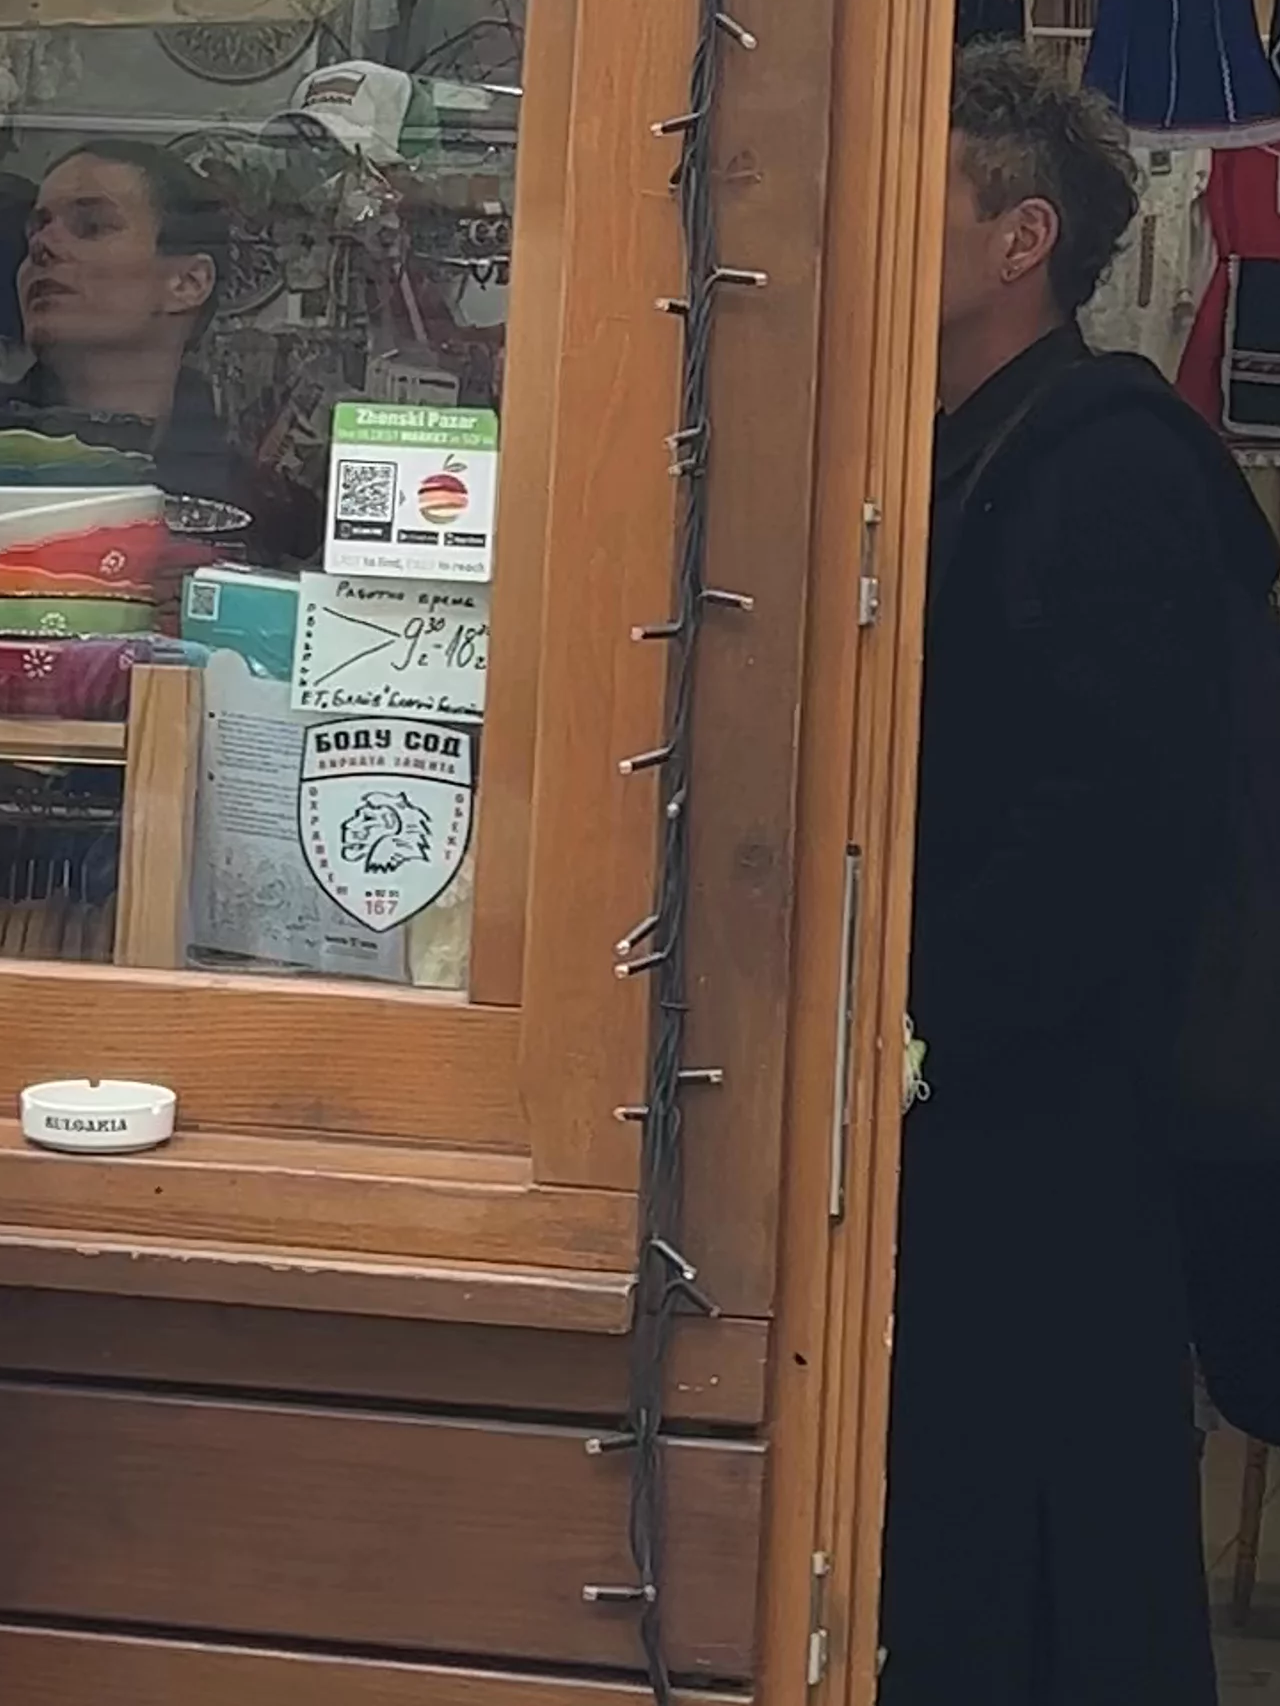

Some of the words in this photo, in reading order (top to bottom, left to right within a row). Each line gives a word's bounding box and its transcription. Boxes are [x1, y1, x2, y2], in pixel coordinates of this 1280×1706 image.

[356, 408, 424, 427] Zhenski
[427, 411, 478, 429] Pazar
[404, 730, 462, 758] СОД
[365, 900, 399, 916] 167
